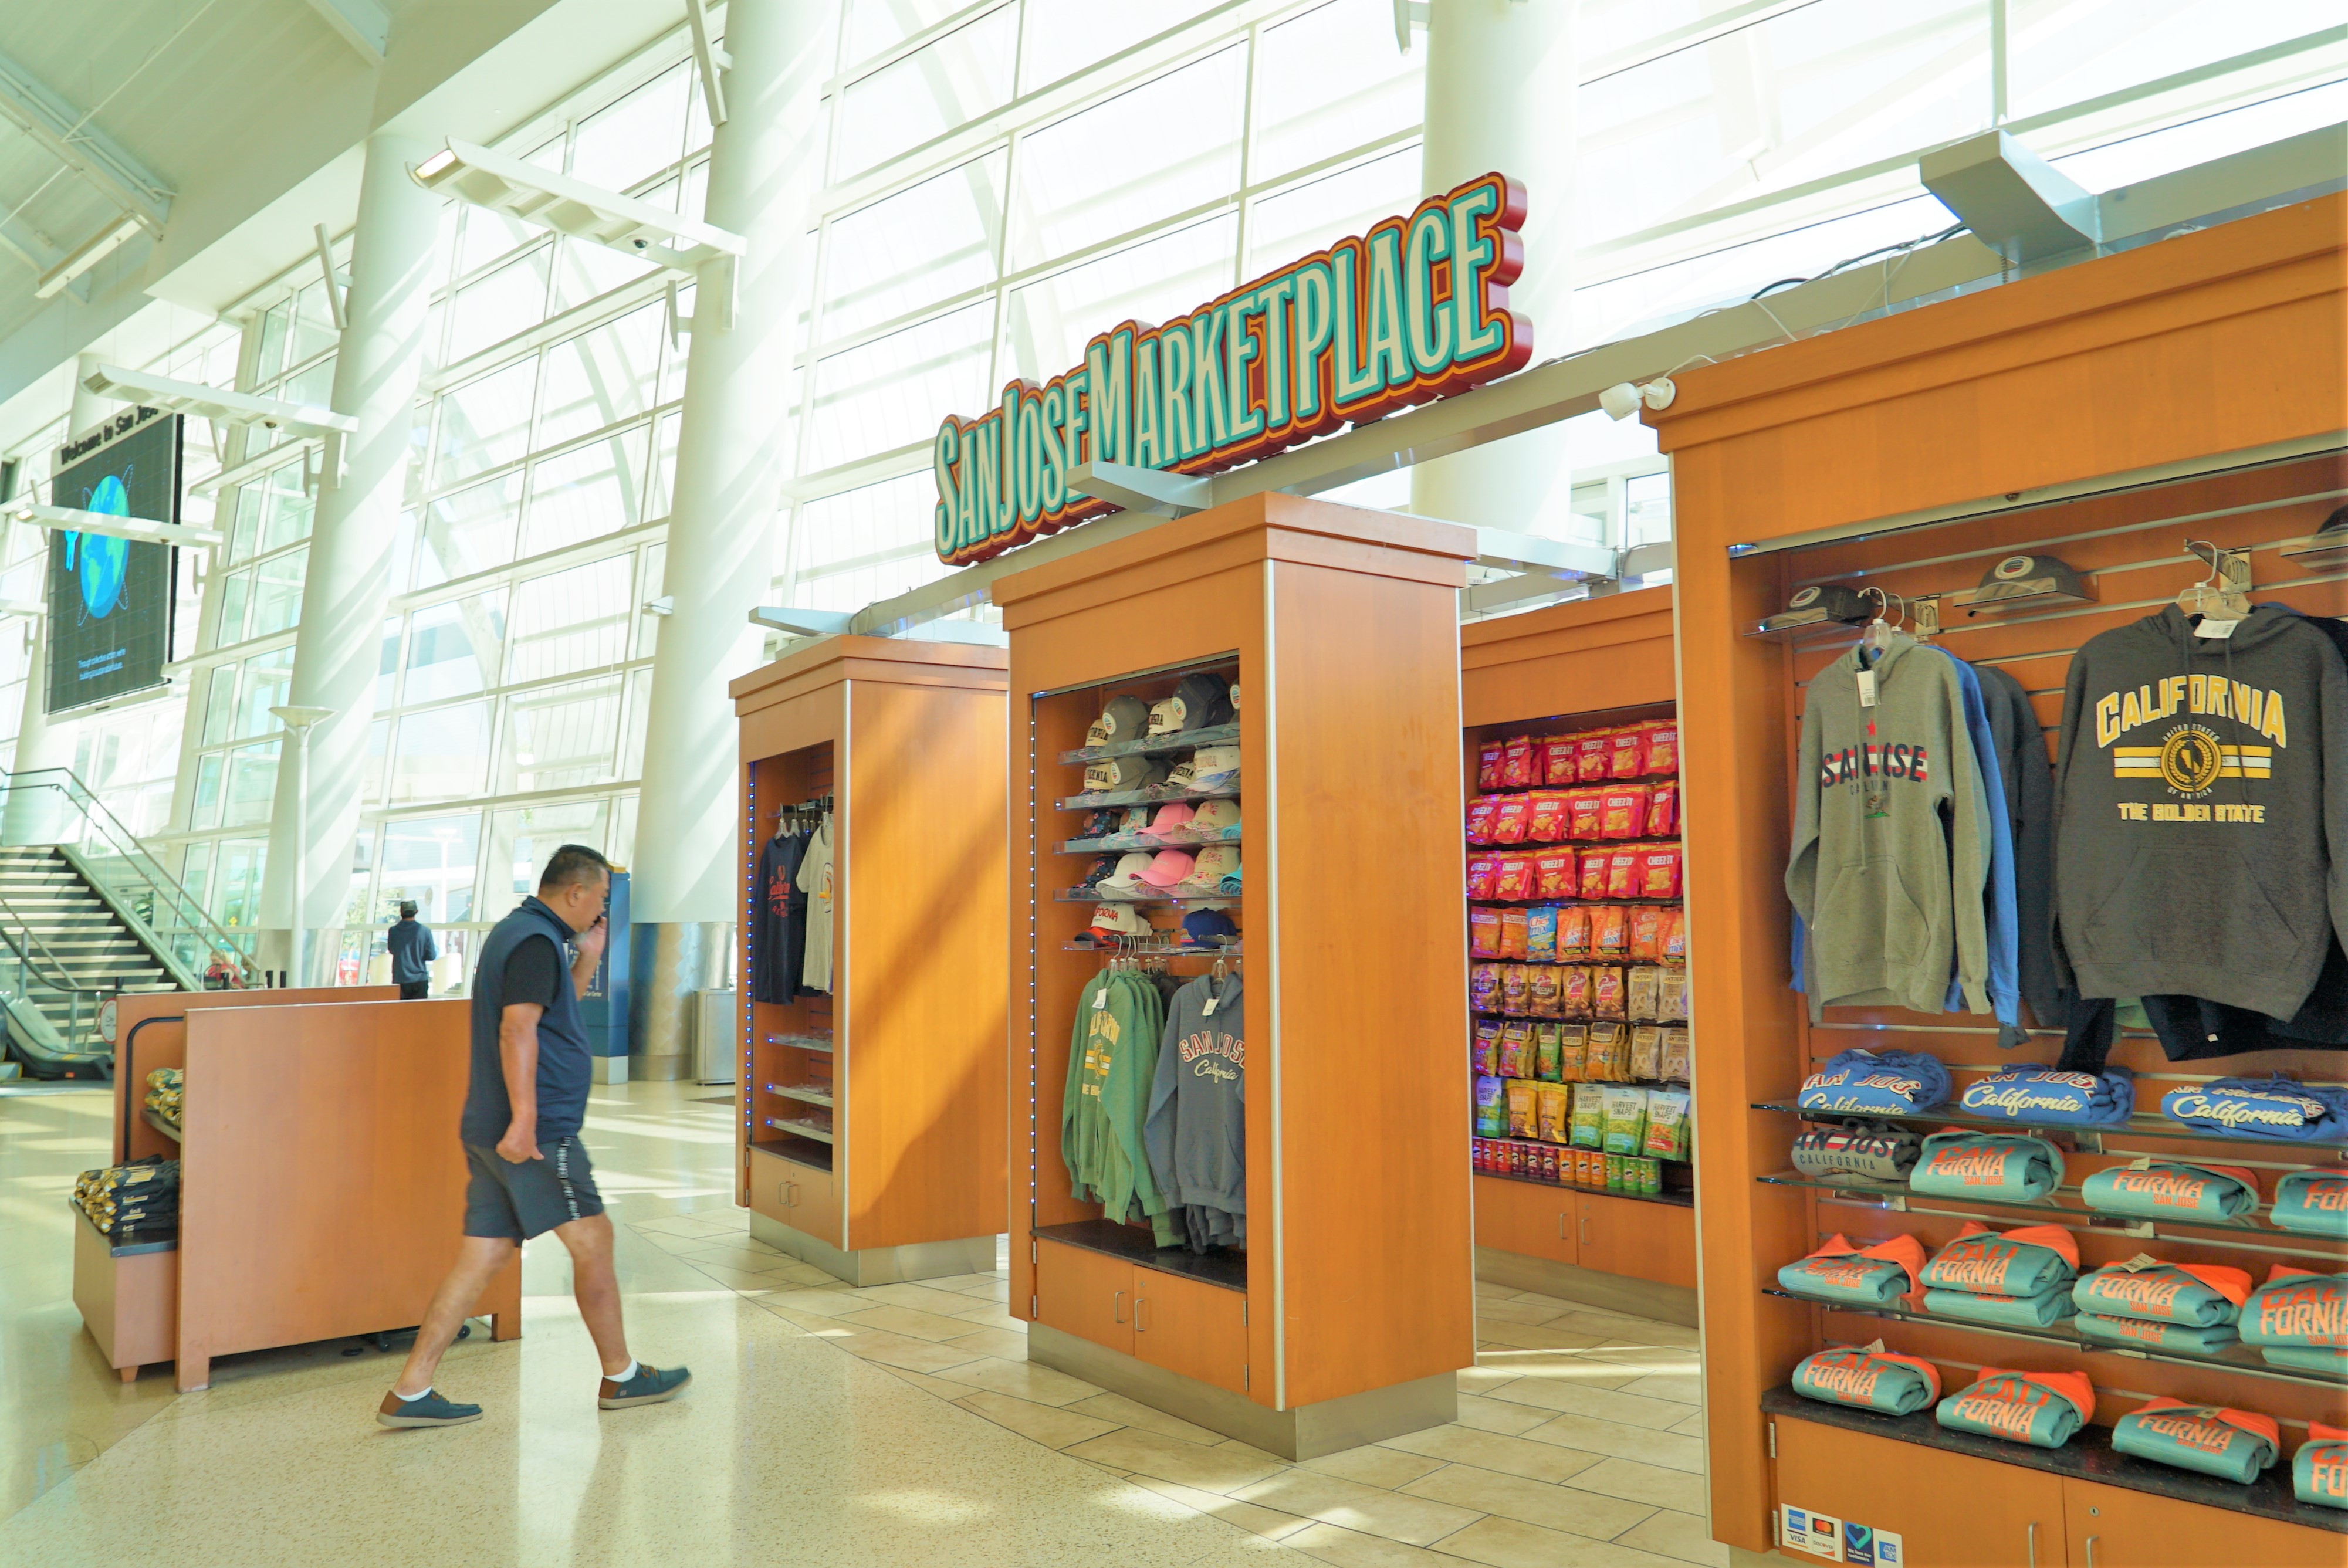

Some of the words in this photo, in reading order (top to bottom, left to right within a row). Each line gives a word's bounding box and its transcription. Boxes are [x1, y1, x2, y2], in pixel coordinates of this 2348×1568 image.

[935, 415, 1006, 557] SAN
[1087, 183, 1506, 474] MARKETPLACE
[61, 432, 101, 465] Welcome
[104, 425, 114, 442] to
[116, 414, 134, 435] San
[2096, 673, 2286, 749] CALIFORNIA
[2161, 723, 2189, 742] UNITED
[2191, 723, 2221, 742] STATES
[2117, 802, 2149, 821] THE
[2152, 802, 2211, 822] GOLDEN
[2214, 804, 2266, 824] STATE
[1473, 915, 1496, 923] QUEST
[1179, 1030, 1214, 1062] SAN
[1799, 1069, 1850, 1093] AN
[1579, 1095, 1602, 1103] HARVEST
[1612, 1101, 1637, 1110] HARVEST
[1653, 1103, 1677, 1112] HARVEST
[1963, 1085, 2083, 1117] California
[2172, 1095, 2304, 1128] California
[1799, 1154, 1876, 1170] CALIFORNIA
[1935, 1146, 2015, 1164] CALI
[1926, 1155, 2006, 1177] FORNIA
[1964, 1174, 1982, 1186] SAN
[1983, 1175, 2005, 1186] JOSE
[2112, 1175, 2206, 1200] FORNIA
[2153, 1193, 2172, 1206] SAN
[2174, 1195, 2199, 1209] JOSE
[1941, 1241, 2020, 1261] CALI
[1824, 1275, 1839, 1285] SAN
[1841, 1276, 1862, 1288] JOSE
[1930, 1258, 2008, 1285] FORNIA
[1965, 1283, 1983, 1293] SAN
[1985, 1283, 2005, 1294] JOSE
[2089, 1276, 2183, 1307] FORNIA
[2260, 1287, 2348, 1310] CAL
[2129, 1301, 2148, 1313] SAN
[2150, 1303, 2174, 1318] JOSE
[2119, 1323, 2138, 1337] SAN
[2139, 1329, 2163, 1344] JOSE
[2307, 1335, 2330, 1345] SAN
[1803, 1364, 1879, 1396] FORNIA
[1836, 1391, 1854, 1403] SAN
[1855, 1393, 1873, 1406] JOSE
[1965, 1380, 2052, 1407] CALI
[1954, 1397, 2039, 1434] FORNIA
[1990, 1425, 2009, 1436] SAN
[2011, 1428, 2031, 1442] JOSE
[2137, 1416, 2235, 1451] FORNIA
[2176, 1438, 2196, 1448] SAN
[2196, 1442, 2223, 1455] JOSE
[1789, 1533, 1806, 1544] VISA
